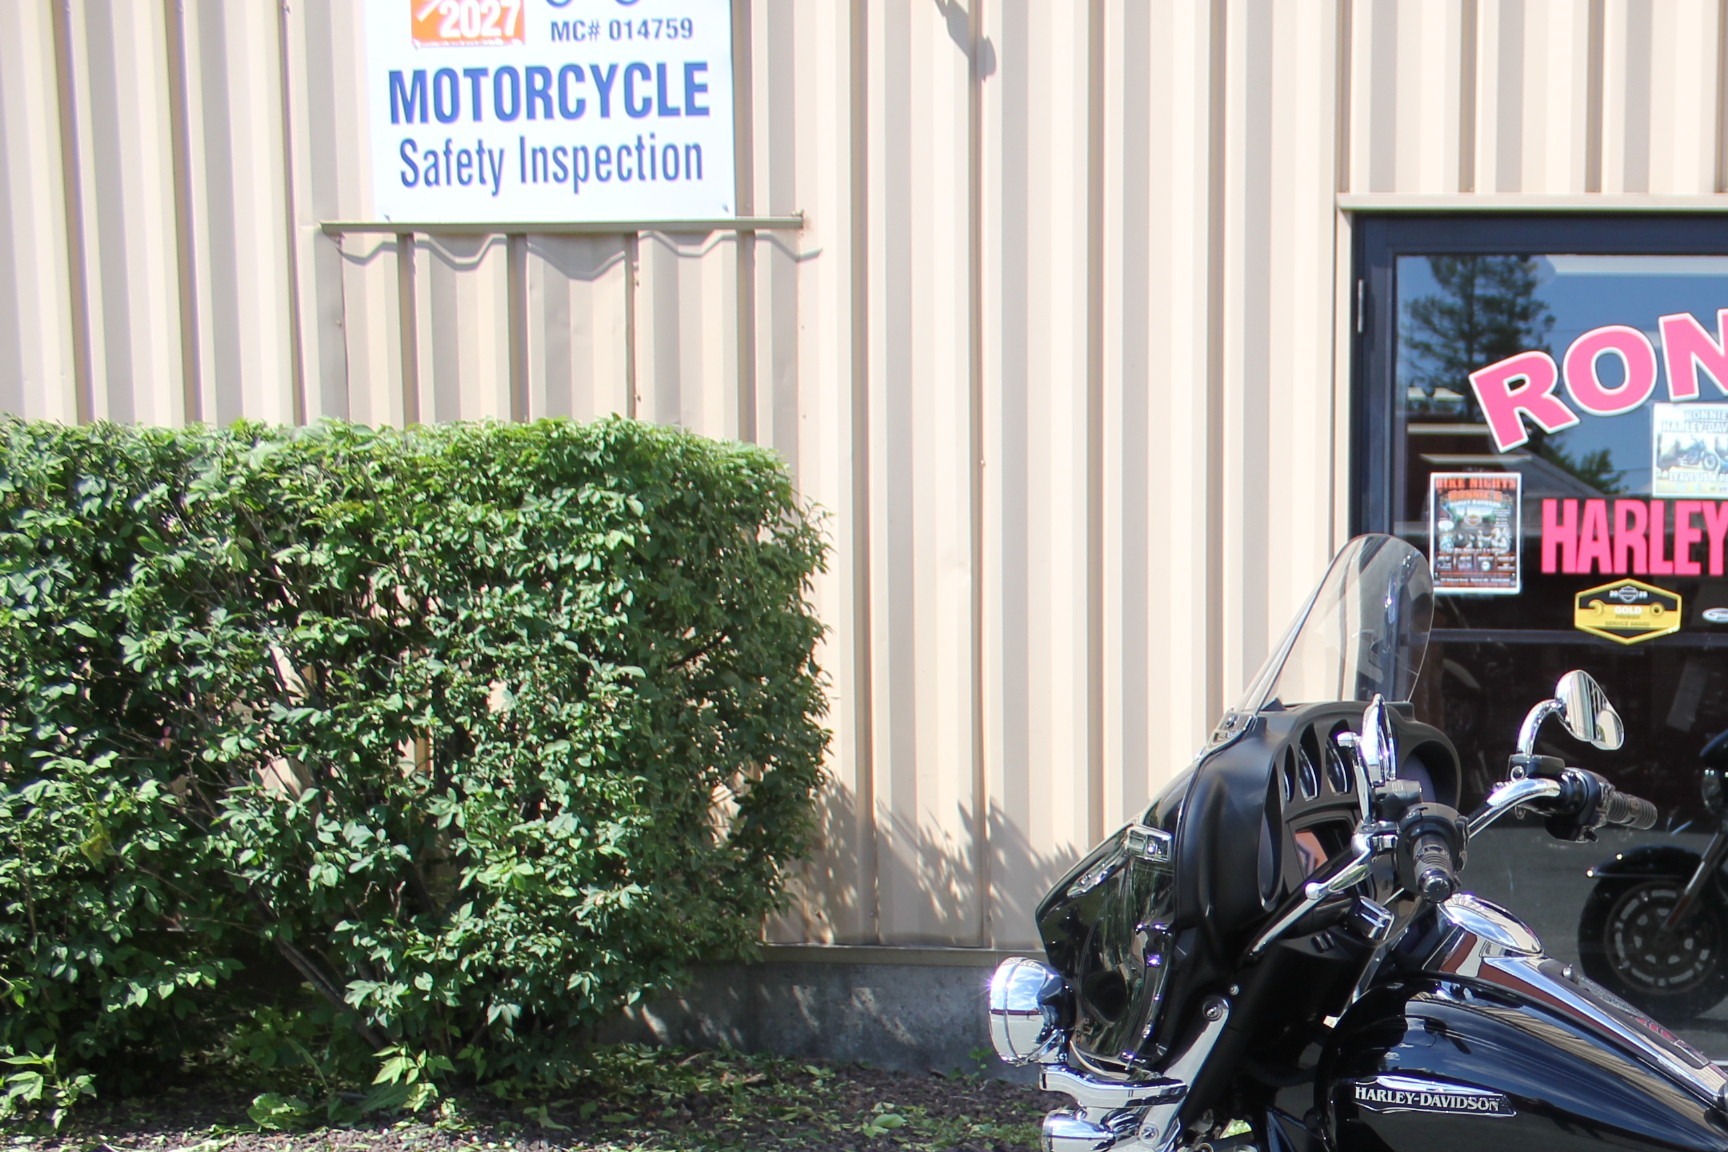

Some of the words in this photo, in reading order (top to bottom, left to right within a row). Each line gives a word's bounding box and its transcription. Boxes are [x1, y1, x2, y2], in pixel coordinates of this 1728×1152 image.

[550, 20, 600, 42] MC#
[609, 18, 694, 41] 014759
[388, 61, 710, 125] MOTORCYCLE
[399, 138, 504, 197] Safety
[519, 133, 703, 194] Inspection
[1614, 605, 1642, 615] GOLD
[1355, 1086, 1499, 1111] HARLEY-DAVIDSON
